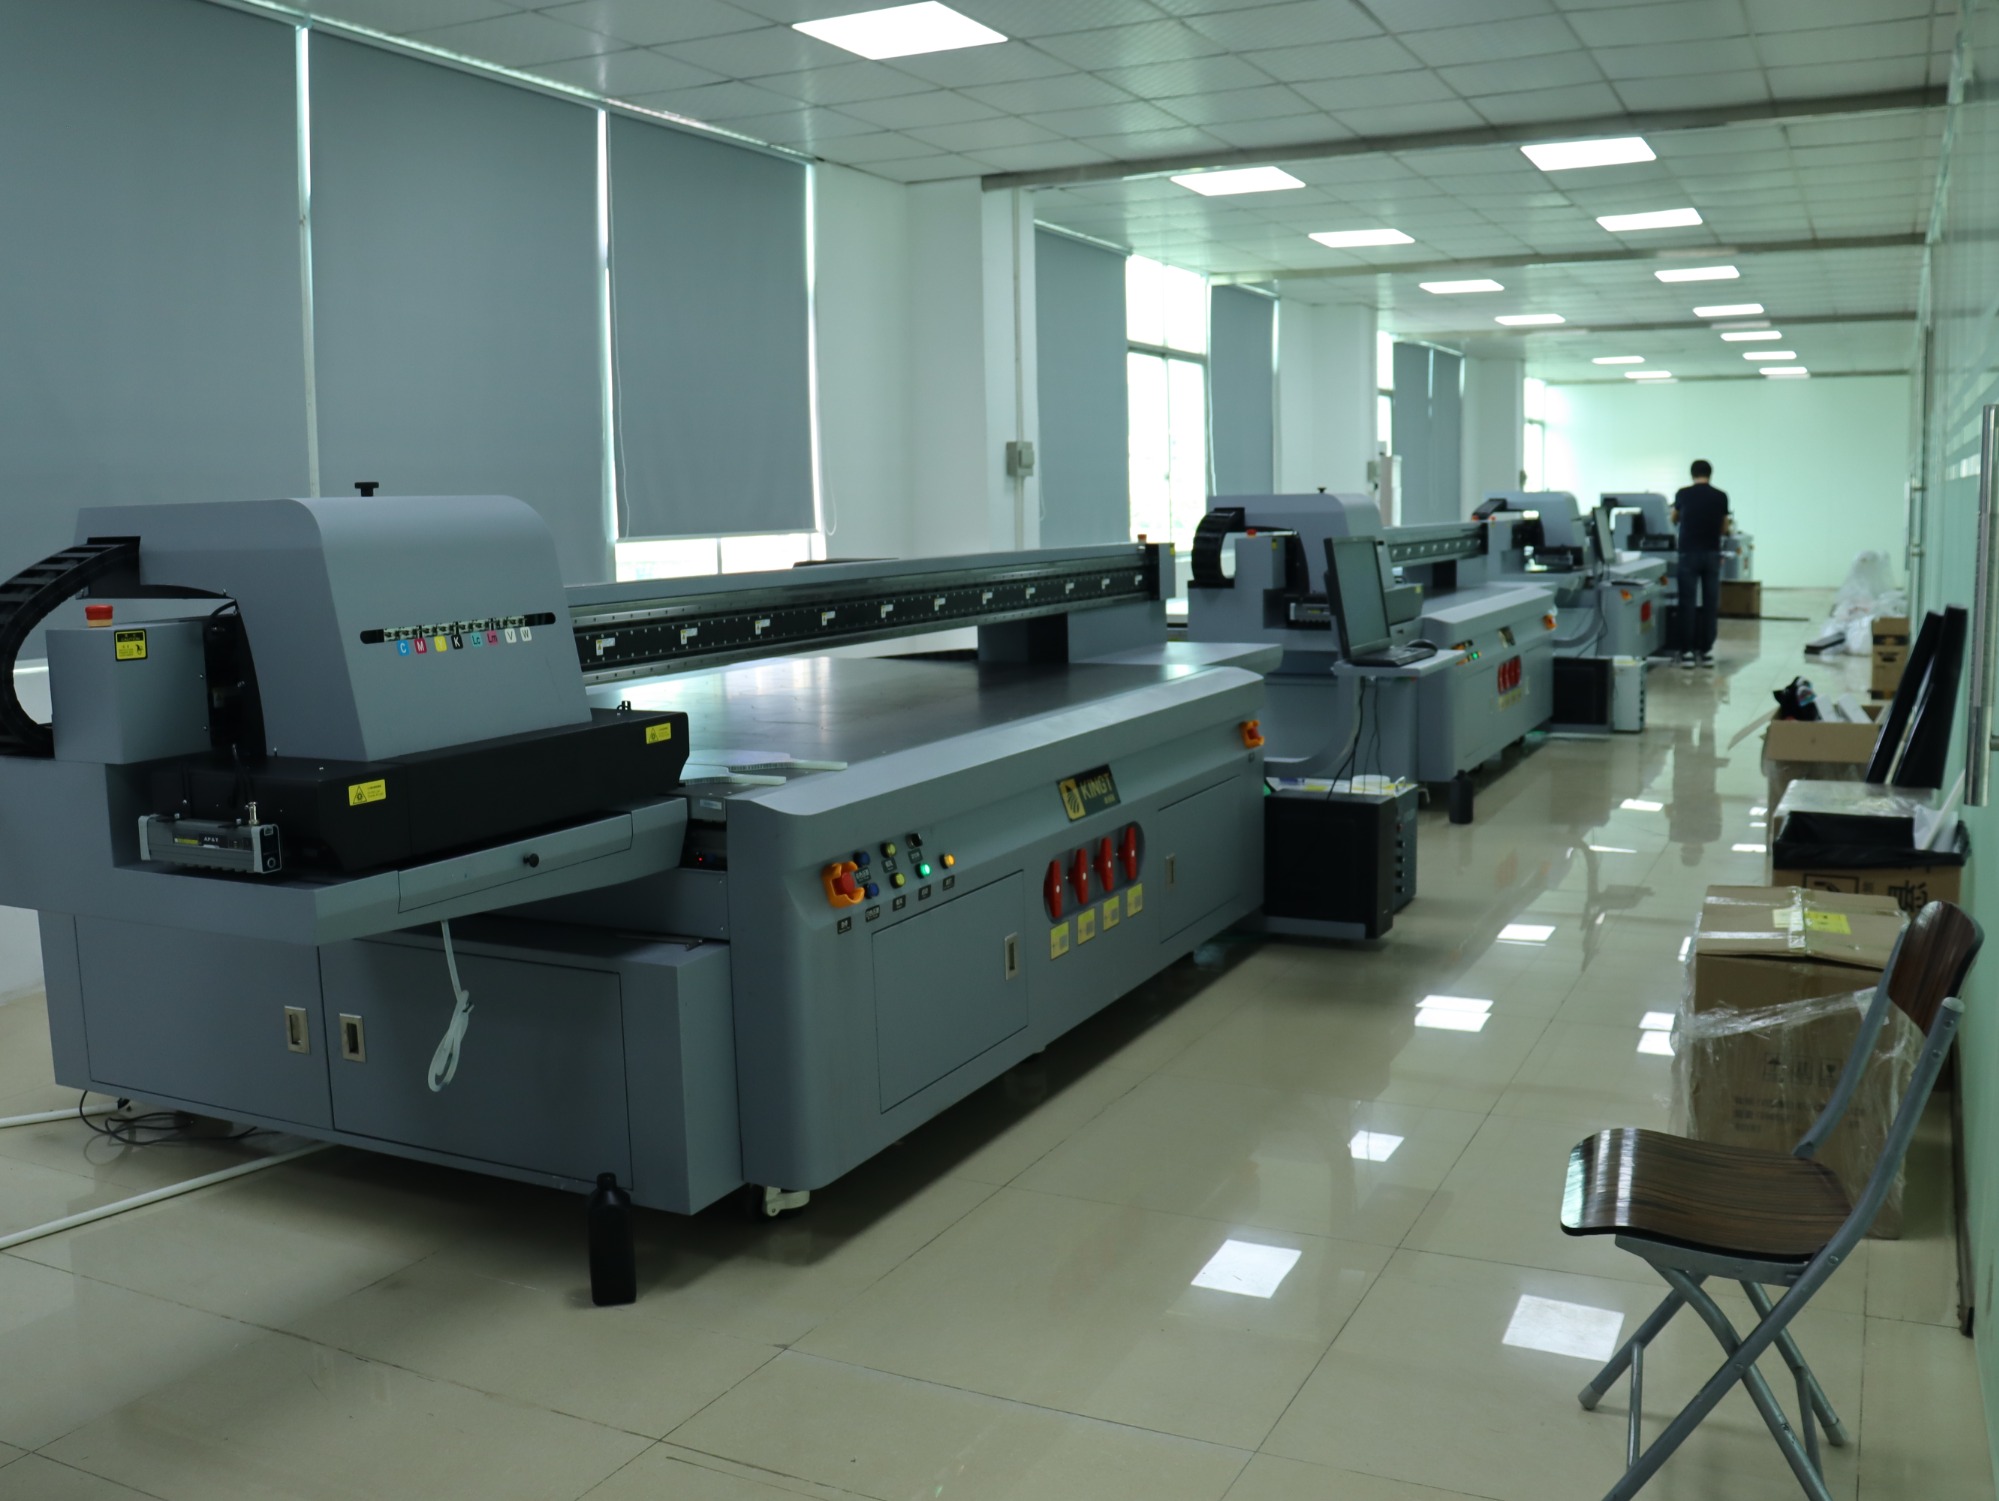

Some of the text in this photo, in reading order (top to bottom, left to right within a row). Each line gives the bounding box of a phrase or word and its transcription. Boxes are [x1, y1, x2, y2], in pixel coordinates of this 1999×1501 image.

[400, 642, 407, 653] C
[416, 640, 425, 652] M
[453, 636, 461, 647] K
[471, 634, 481, 645] Lc
[487, 632, 498, 643] Lm
[521, 629, 530, 640] W
